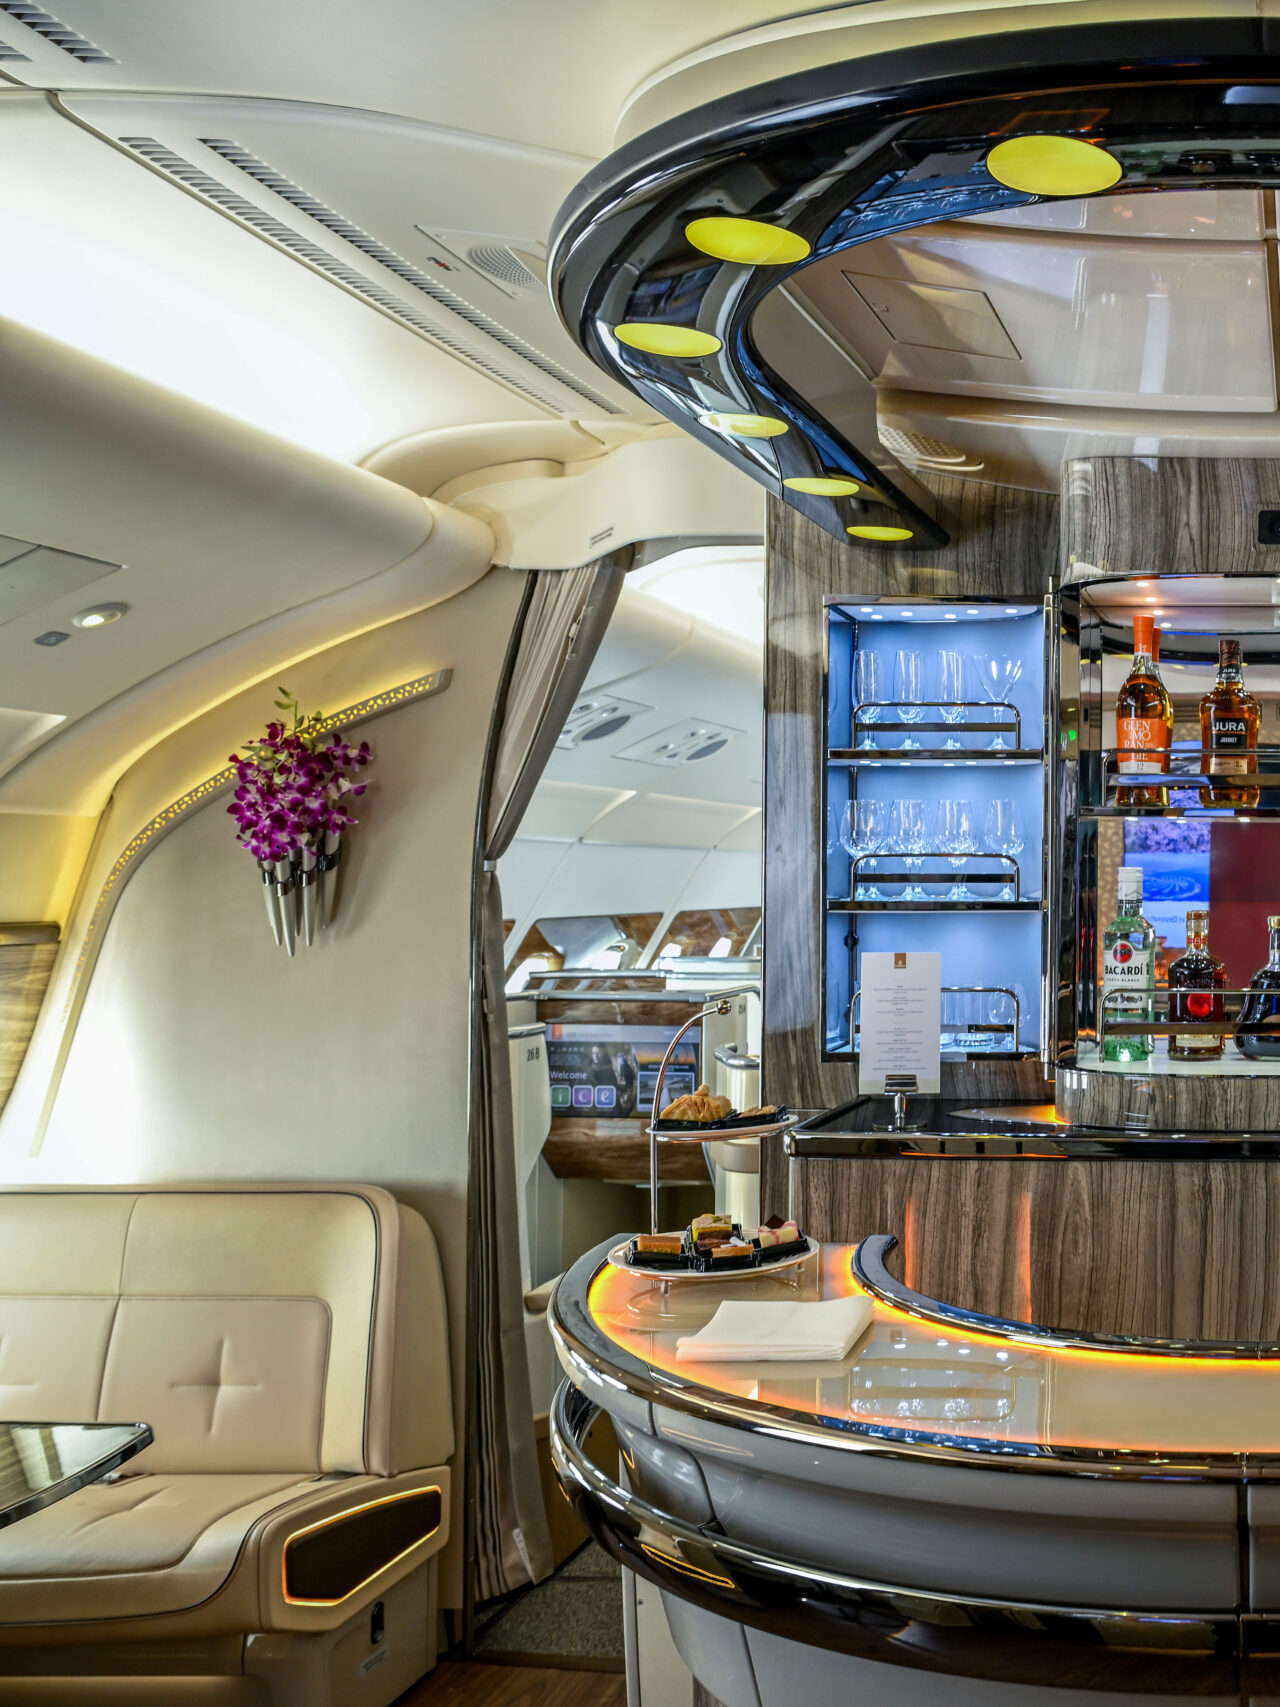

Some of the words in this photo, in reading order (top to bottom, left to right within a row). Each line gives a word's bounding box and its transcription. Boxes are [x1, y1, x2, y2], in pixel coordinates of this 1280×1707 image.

[1124, 720, 1150, 731] GLEN
[1213, 722, 1246, 731] JURA
[1131, 731, 1151, 741] MO
[1124, 740, 1145, 749] RAN
[1105, 963, 1143, 975] BACARDÍ
[527, 1049, 535, 1061] 26
[535, 1047, 540, 1060] B
[550, 1071, 587, 1079] Welcome
[601, 1089, 609, 1100] e
